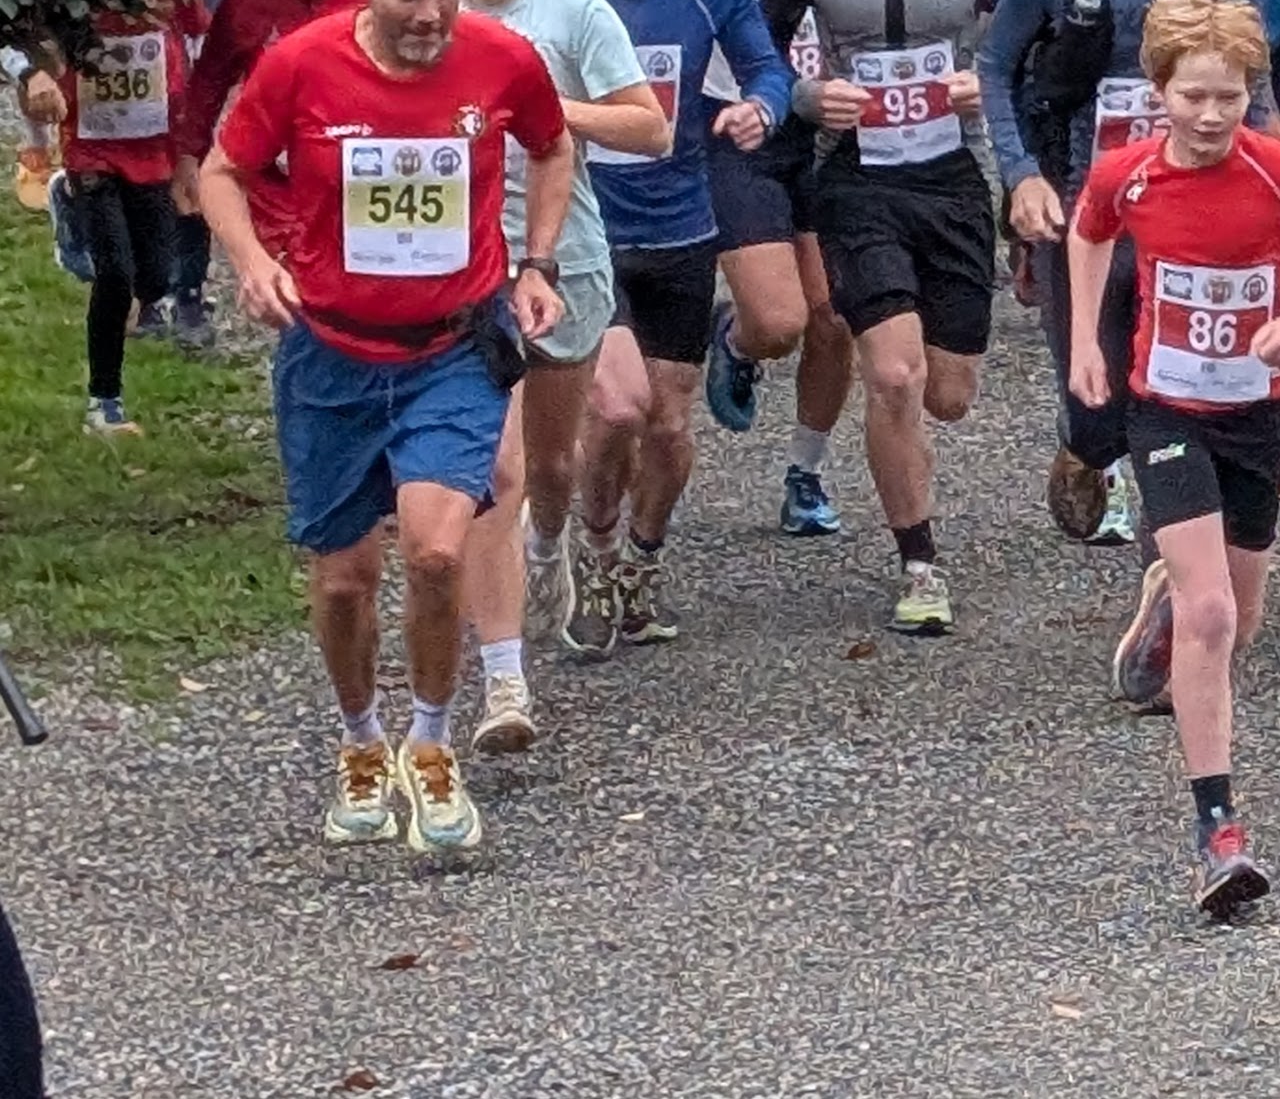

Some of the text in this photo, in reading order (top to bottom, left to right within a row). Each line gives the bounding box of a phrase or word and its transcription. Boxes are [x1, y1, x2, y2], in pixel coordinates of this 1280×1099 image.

[95, 68, 151, 101] 536
[883, 86, 929, 123] 95
[368, 184, 444, 224] 545
[1188, 311, 1238, 353] 86
